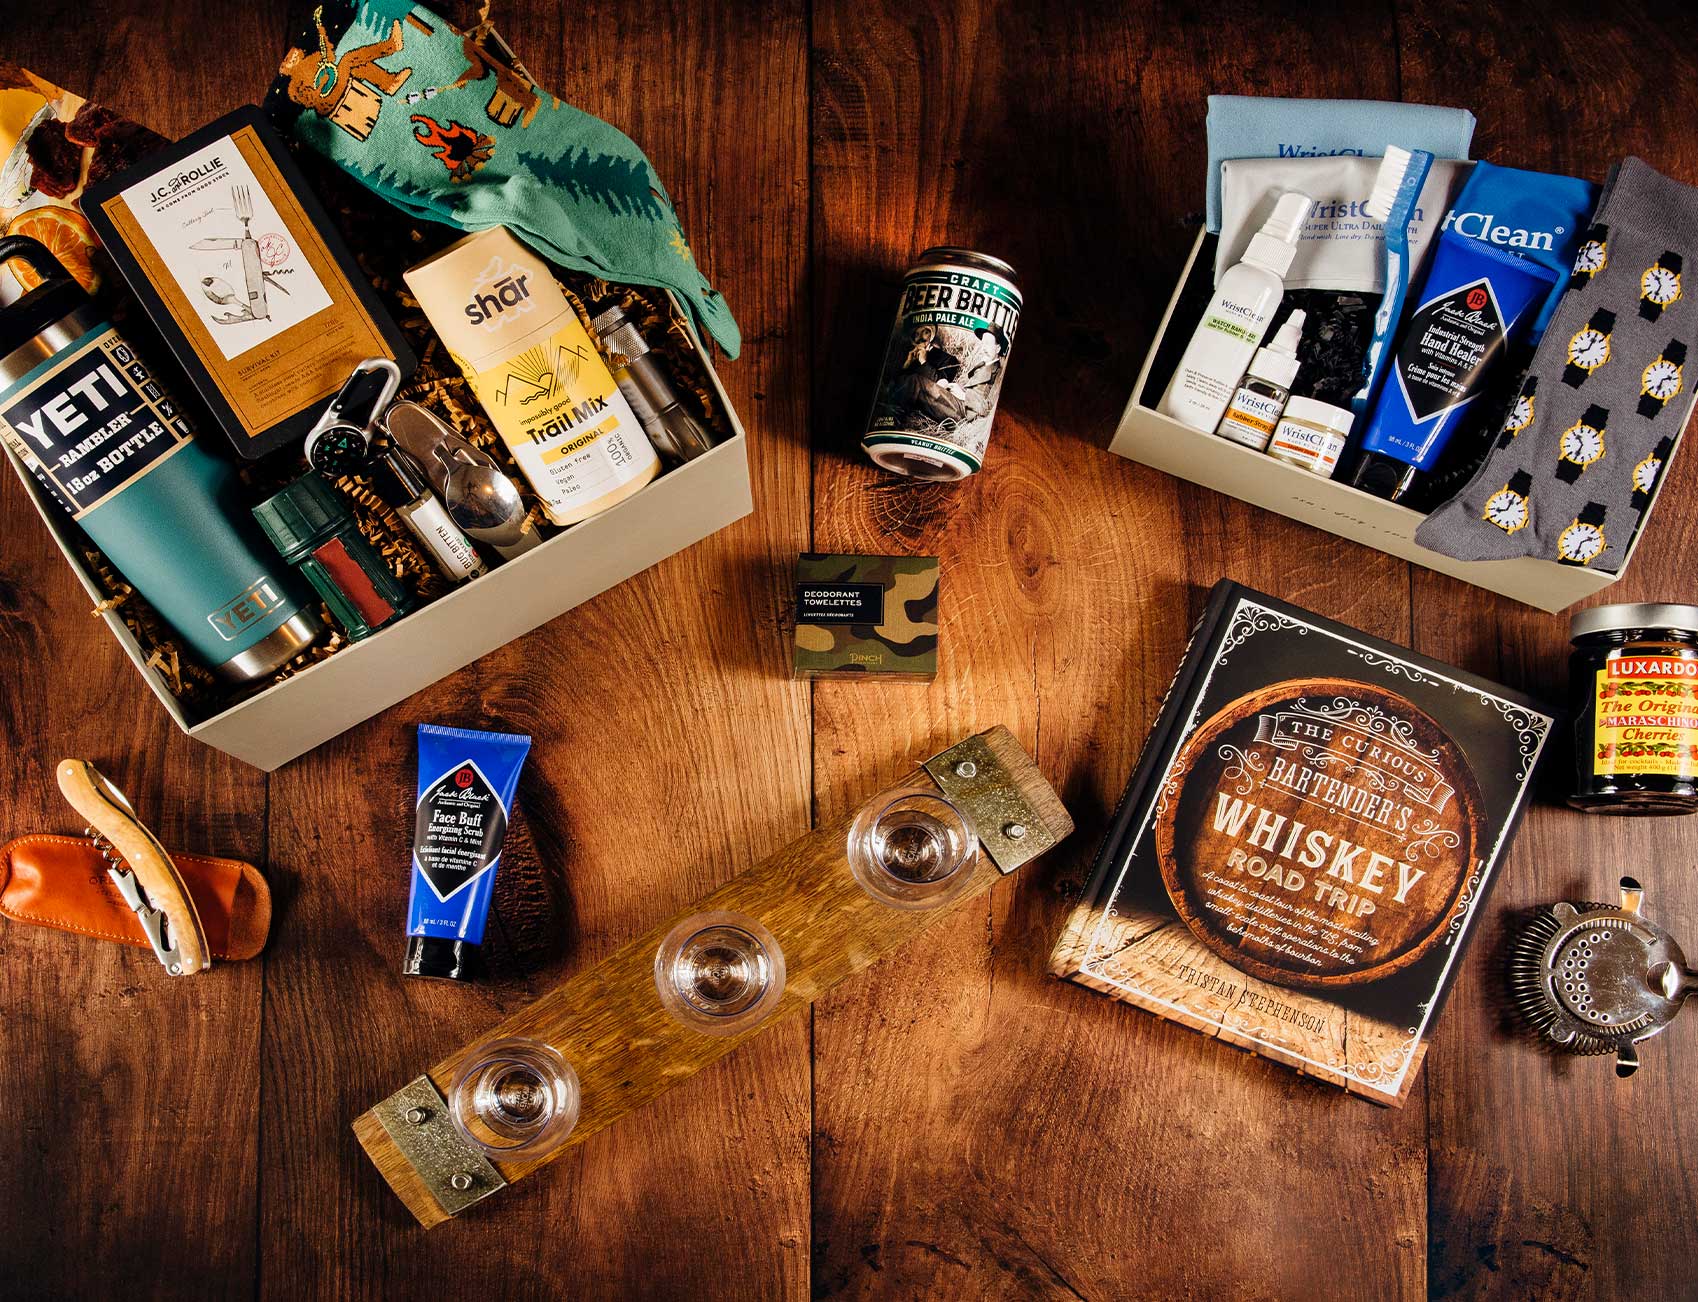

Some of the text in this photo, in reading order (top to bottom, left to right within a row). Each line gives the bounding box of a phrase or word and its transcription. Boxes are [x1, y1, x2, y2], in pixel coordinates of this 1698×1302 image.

[181, 157, 224, 186] ROLLIE
[1362, 221, 1384, 230] DAIL
[950, 274, 1000, 295] CRAFT
[902, 284, 953, 318] BEER
[912, 311, 976, 328] INDIA PALE ALE
[1420, 332, 1482, 366] Hand Healer
[1421, 347, 1434, 356] with
[1428, 323, 1486, 353] Industrial Strength
[238, 355, 271, 377] SURVIVAL
[270, 350, 281, 362] KIT
[1407, 363, 1426, 376] Crème
[1426, 370, 1442, 381] pour
[1441, 374, 1450, 385] les
[15, 363, 128, 450] YETI
[519, 397, 571, 427] impossibly good
[571, 394, 609, 424] Mix
[560, 428, 604, 455] ORIGINAL
[911, 440, 956, 455] PEANUT BRITTLE
[66, 470, 101, 495] 18oz
[96, 421, 164, 473] BOTTLE
[549, 453, 591, 477] Gluten free
[435, 523, 472, 570] BUG BITTEN
[215, 583, 278, 631] YETI
[804, 590, 860, 598] DEODORANT
[850, 653, 882, 665] PINCH
[1611, 661, 1697, 677] LUXARDO
[1601, 701, 1632, 713] The
[1606, 716, 1698, 728] MARASCHINO
[1622, 728, 1685, 741] Cherries
[1292, 721, 1427, 783] THE CURIOUS
[1268, 756, 1412, 832] BARTENDER'S
[428, 823, 484, 837] Energizing Scrub
[432, 809, 483, 827] Face Buff
[441, 846, 457, 855] facial
[469, 838, 482, 846] Mint
[1213, 792, 1426, 904] WHISKEY
[449, 857, 472, 866] vitamine
[1227, 848, 1376, 918] ROAD TRIP
[1202, 871, 1380, 947] A coast to coast tour of the most exciting
[1207, 887, 1244, 908] whiskey
[1244, 900, 1293, 926] distilleries
[1302, 922, 1318, 936] the
[1338, 939, 1364, 954] from
[1205, 901, 1258, 927] small-scale
[1258, 922, 1281, 936] craft
[1281, 932, 1329, 956] operations
[1339, 951, 1355, 965] the
[1227, 923, 1323, 967] behemoths of bourbon
[1177, 965, 1326, 1034] TRISTAN STEPHENSON
